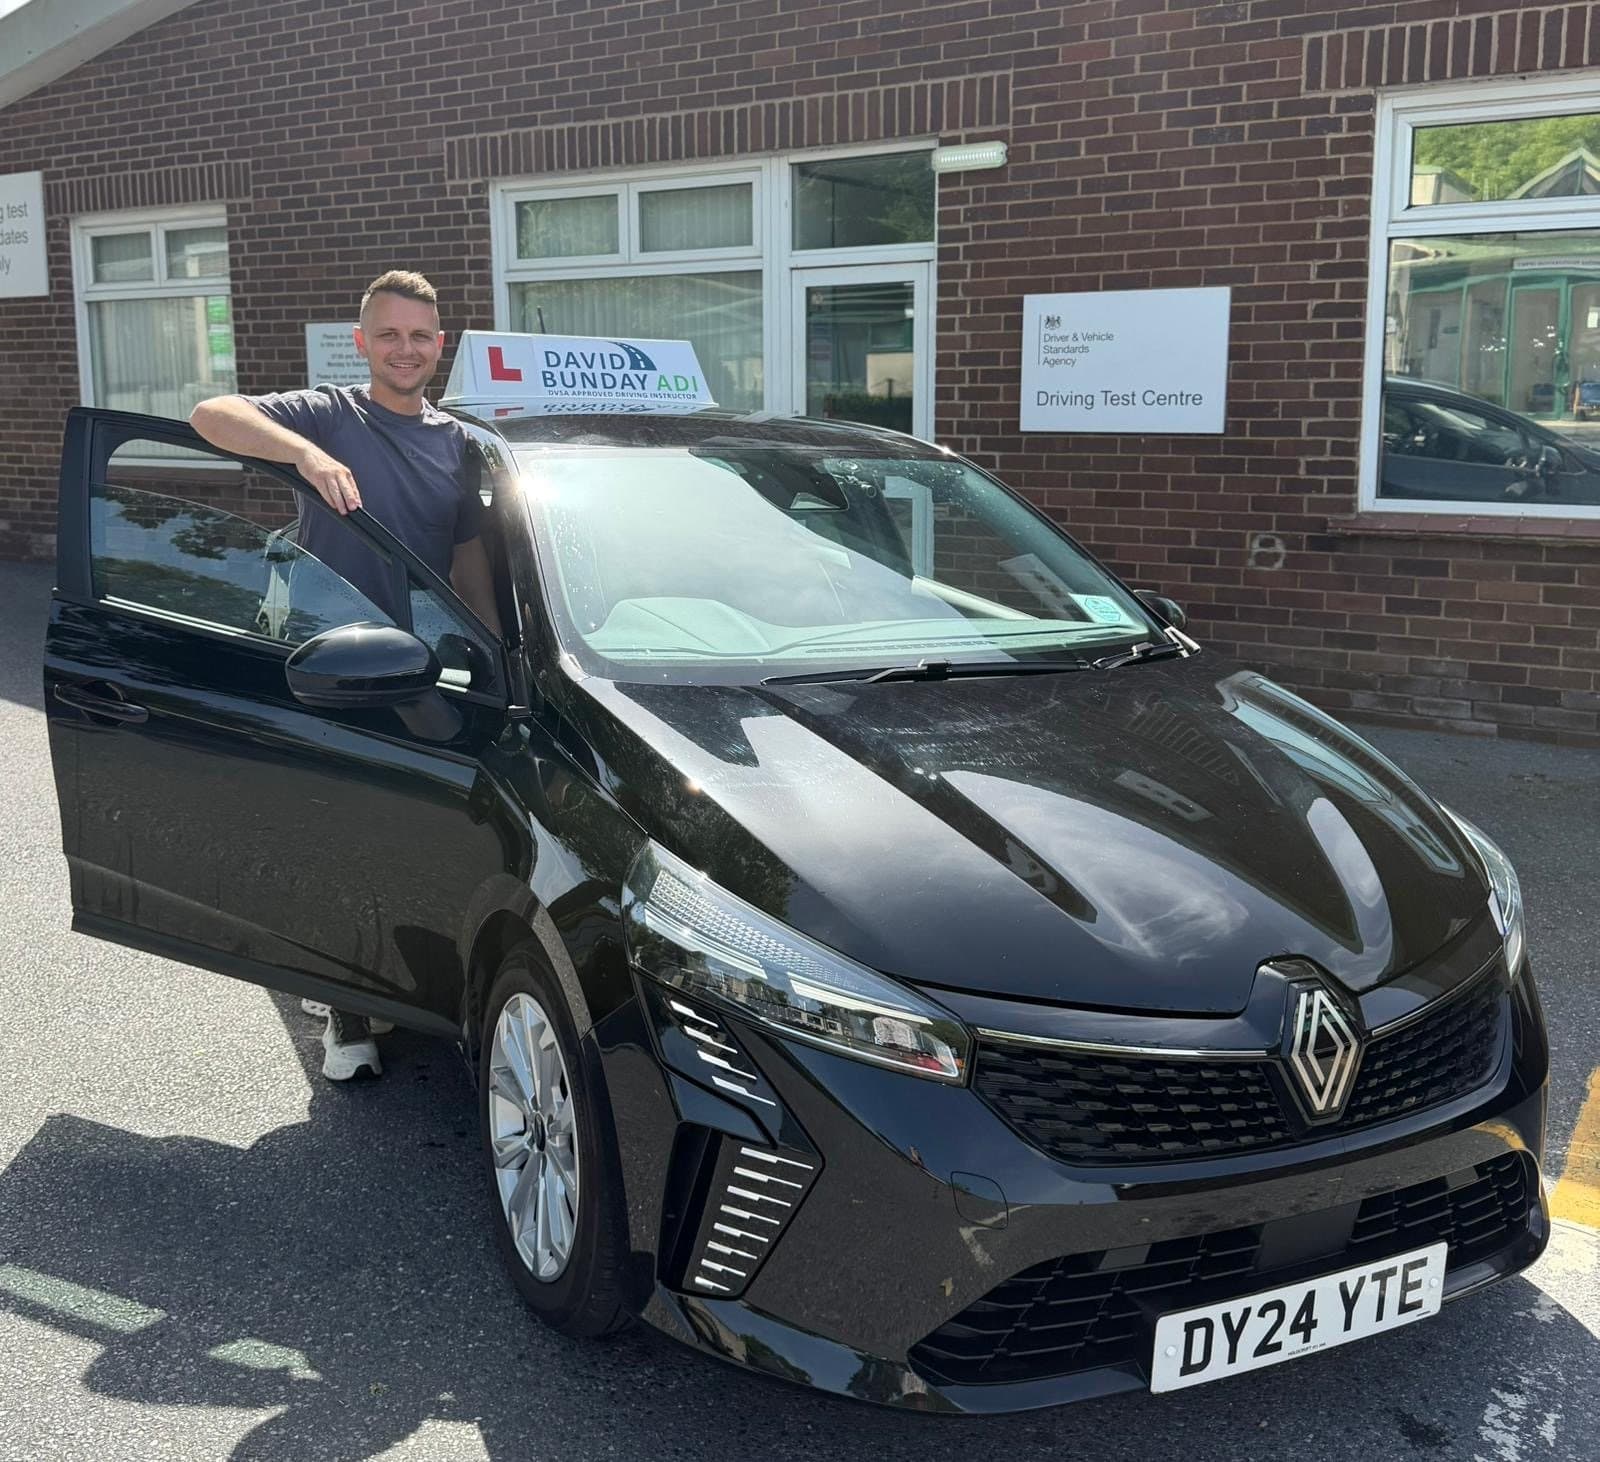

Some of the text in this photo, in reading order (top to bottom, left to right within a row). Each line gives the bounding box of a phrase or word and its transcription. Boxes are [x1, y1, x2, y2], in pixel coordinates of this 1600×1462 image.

[7, 201, 28, 219] test
[1043, 332, 1114, 342] Driver & Vehicle
[1043, 344, 1090, 354] Standards
[487, 346, 523, 382] L
[544, 350, 625, 370] DAVID
[1042, 356, 1077, 367] Agency
[541, 370, 699, 392] BUNDAY ADI
[1036, 389, 1203, 410] Driving Test Centre
[1179, 1256, 1429, 1377] DY24 YTE
